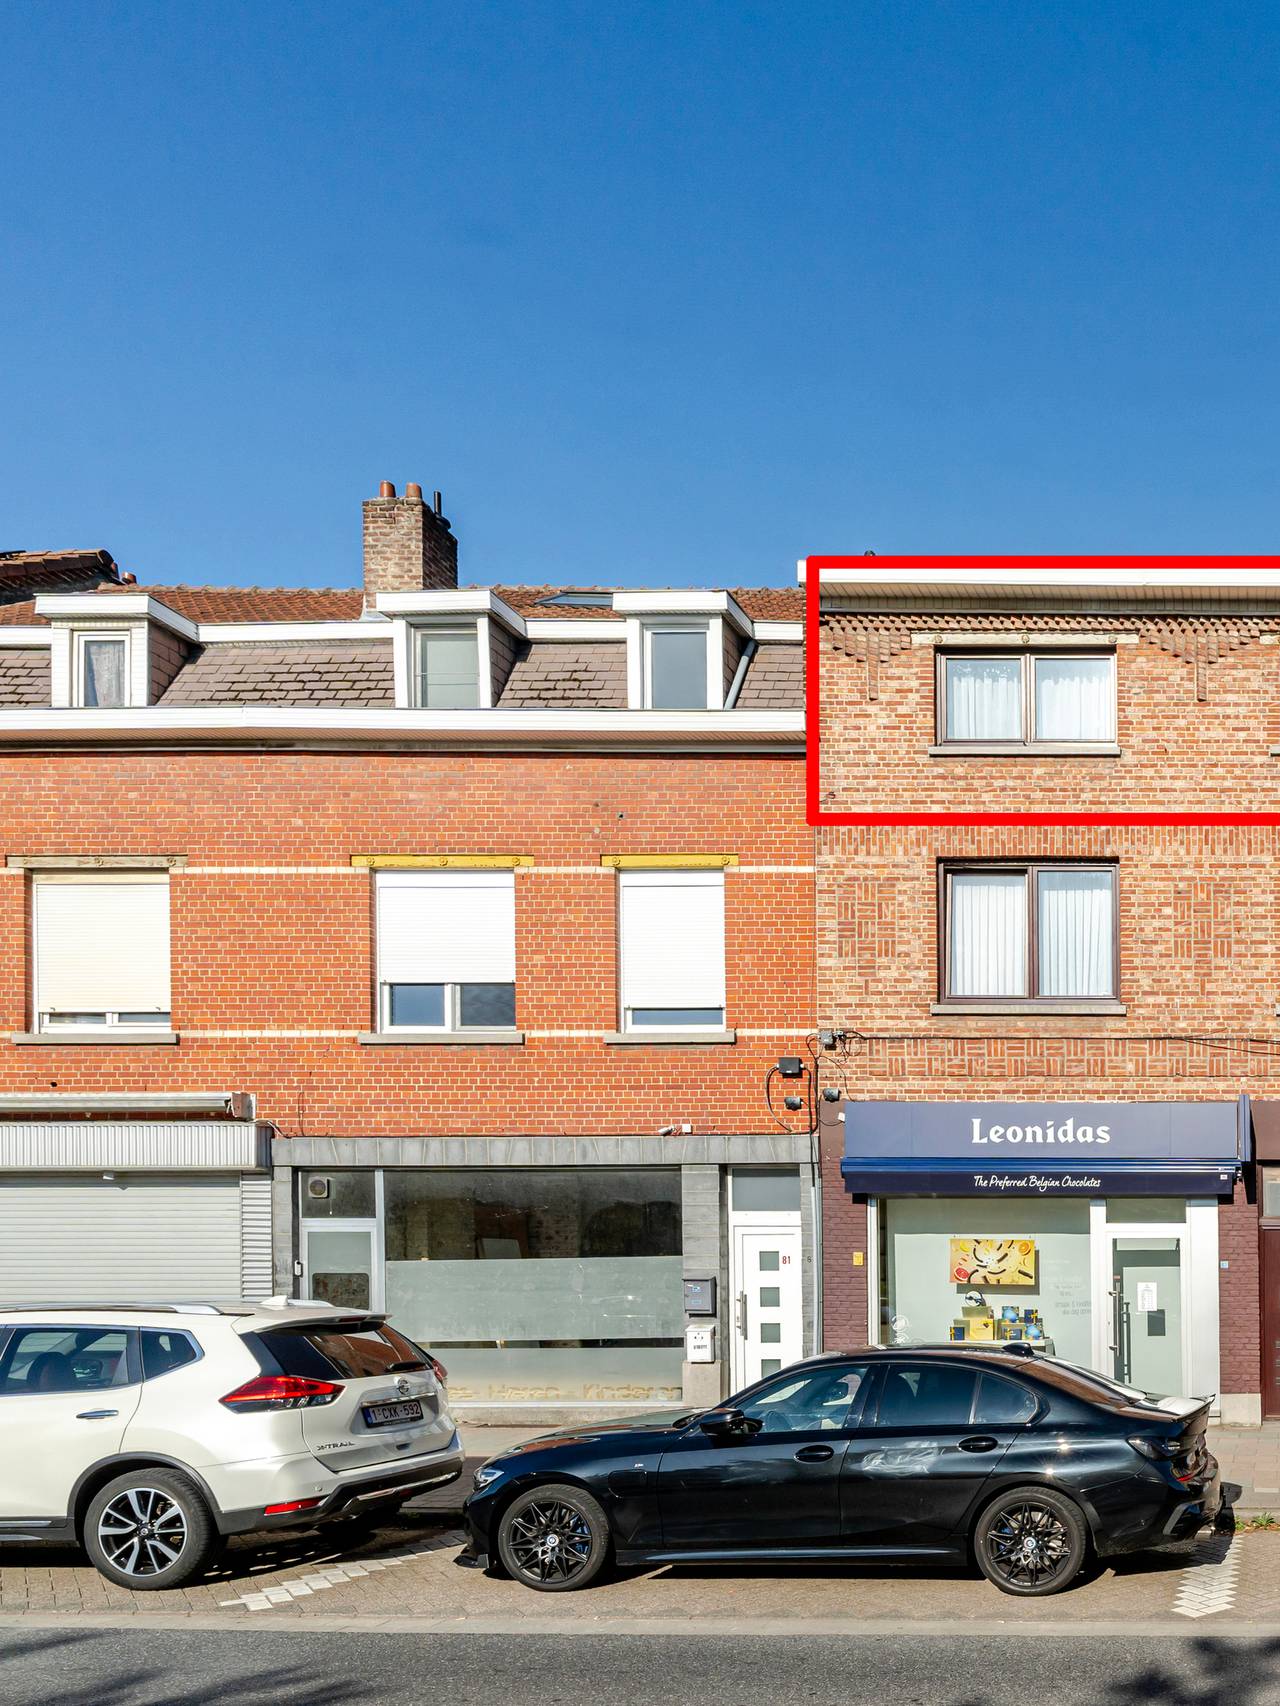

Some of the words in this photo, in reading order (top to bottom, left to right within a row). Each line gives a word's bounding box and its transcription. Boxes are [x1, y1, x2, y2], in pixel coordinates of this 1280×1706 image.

[971, 1116, 1111, 1144] Leonidas
[974, 1175, 988, 1187] The
[988, 1174, 1028, 1190] Preferred
[1028, 1175, 1060, 1192] Belgian
[1061, 1175, 1101, 1188] Chocolates
[782, 1256, 791, 1264] 81
